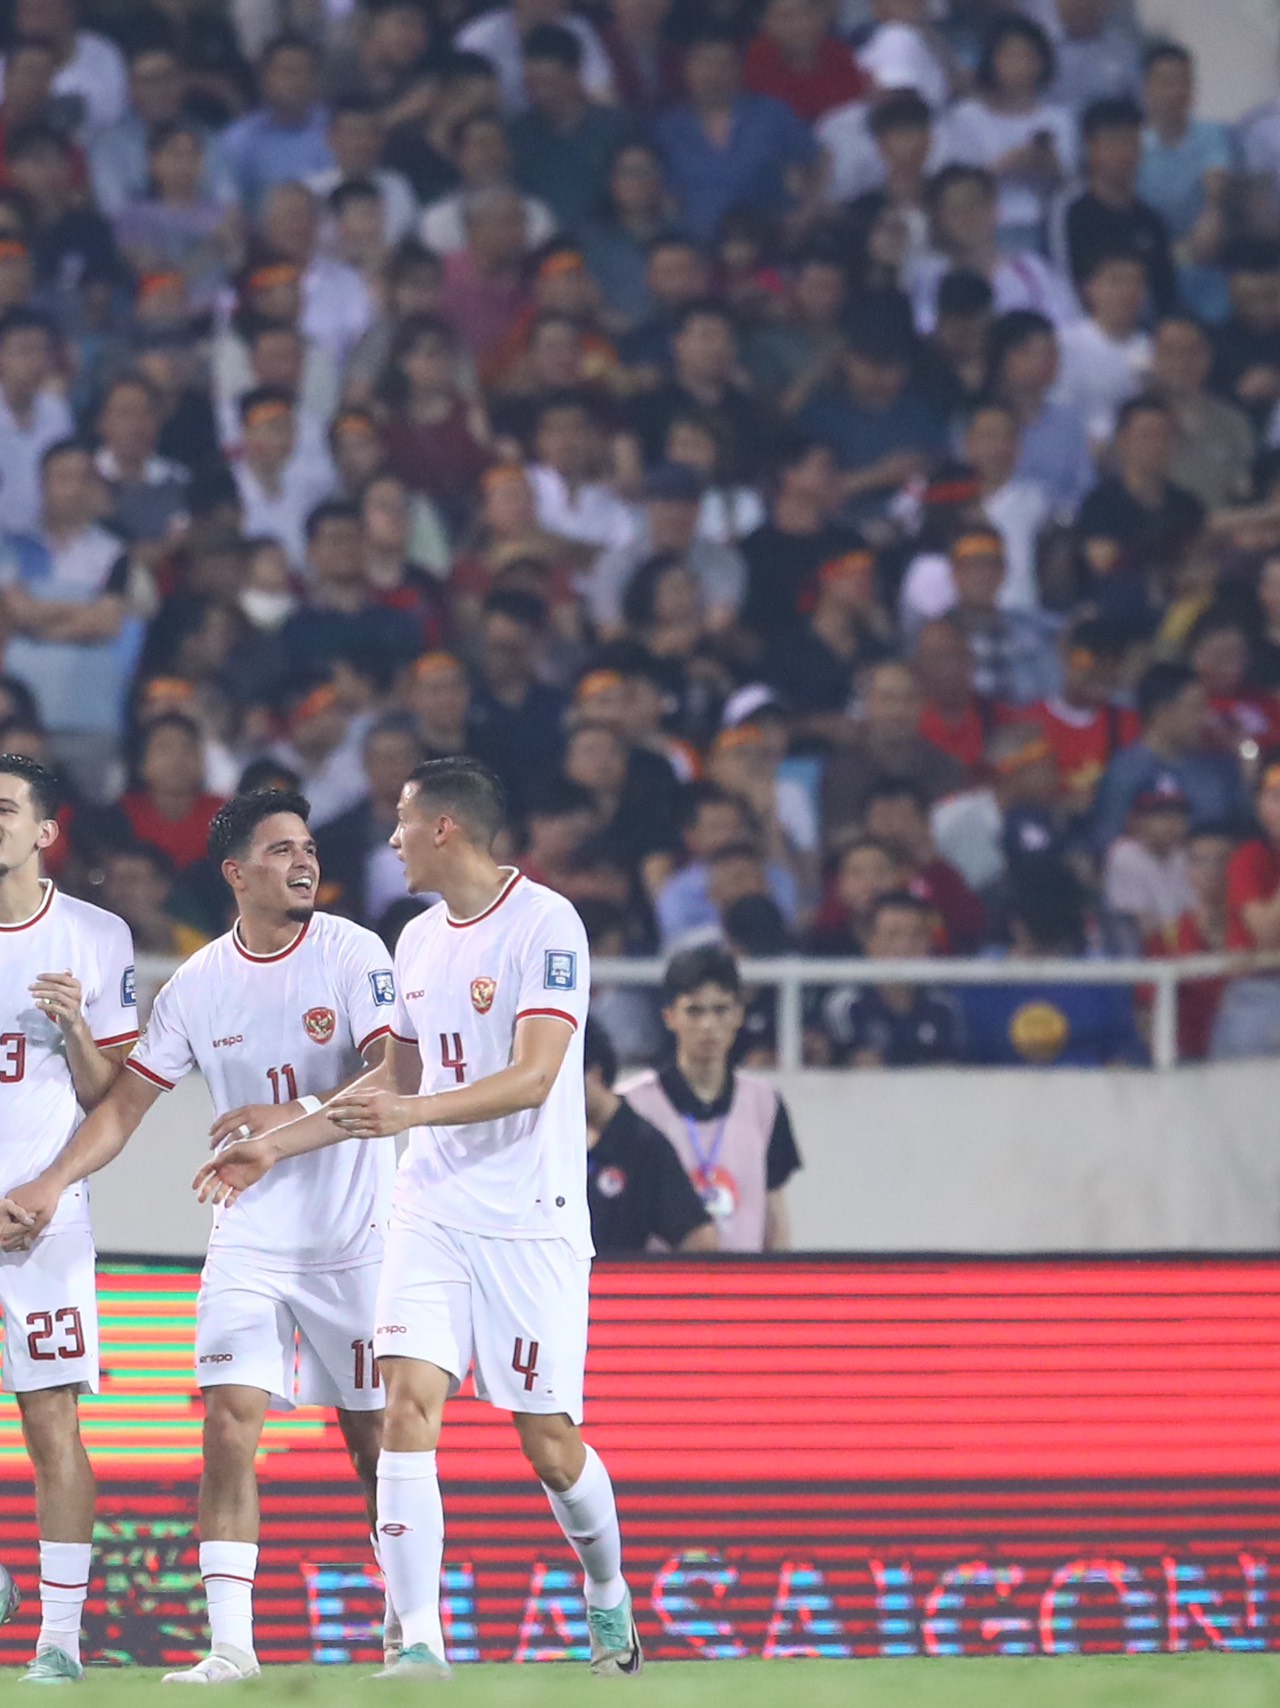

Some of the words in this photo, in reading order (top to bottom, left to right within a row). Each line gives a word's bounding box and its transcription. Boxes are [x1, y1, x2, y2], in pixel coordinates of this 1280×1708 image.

[440, 1033, 467, 1083] 4
[266, 1063, 298, 1105] 11
[26, 1306, 86, 1361] 23
[351, 1339, 379, 1389] 11
[511, 1337, 538, 1391] 4
